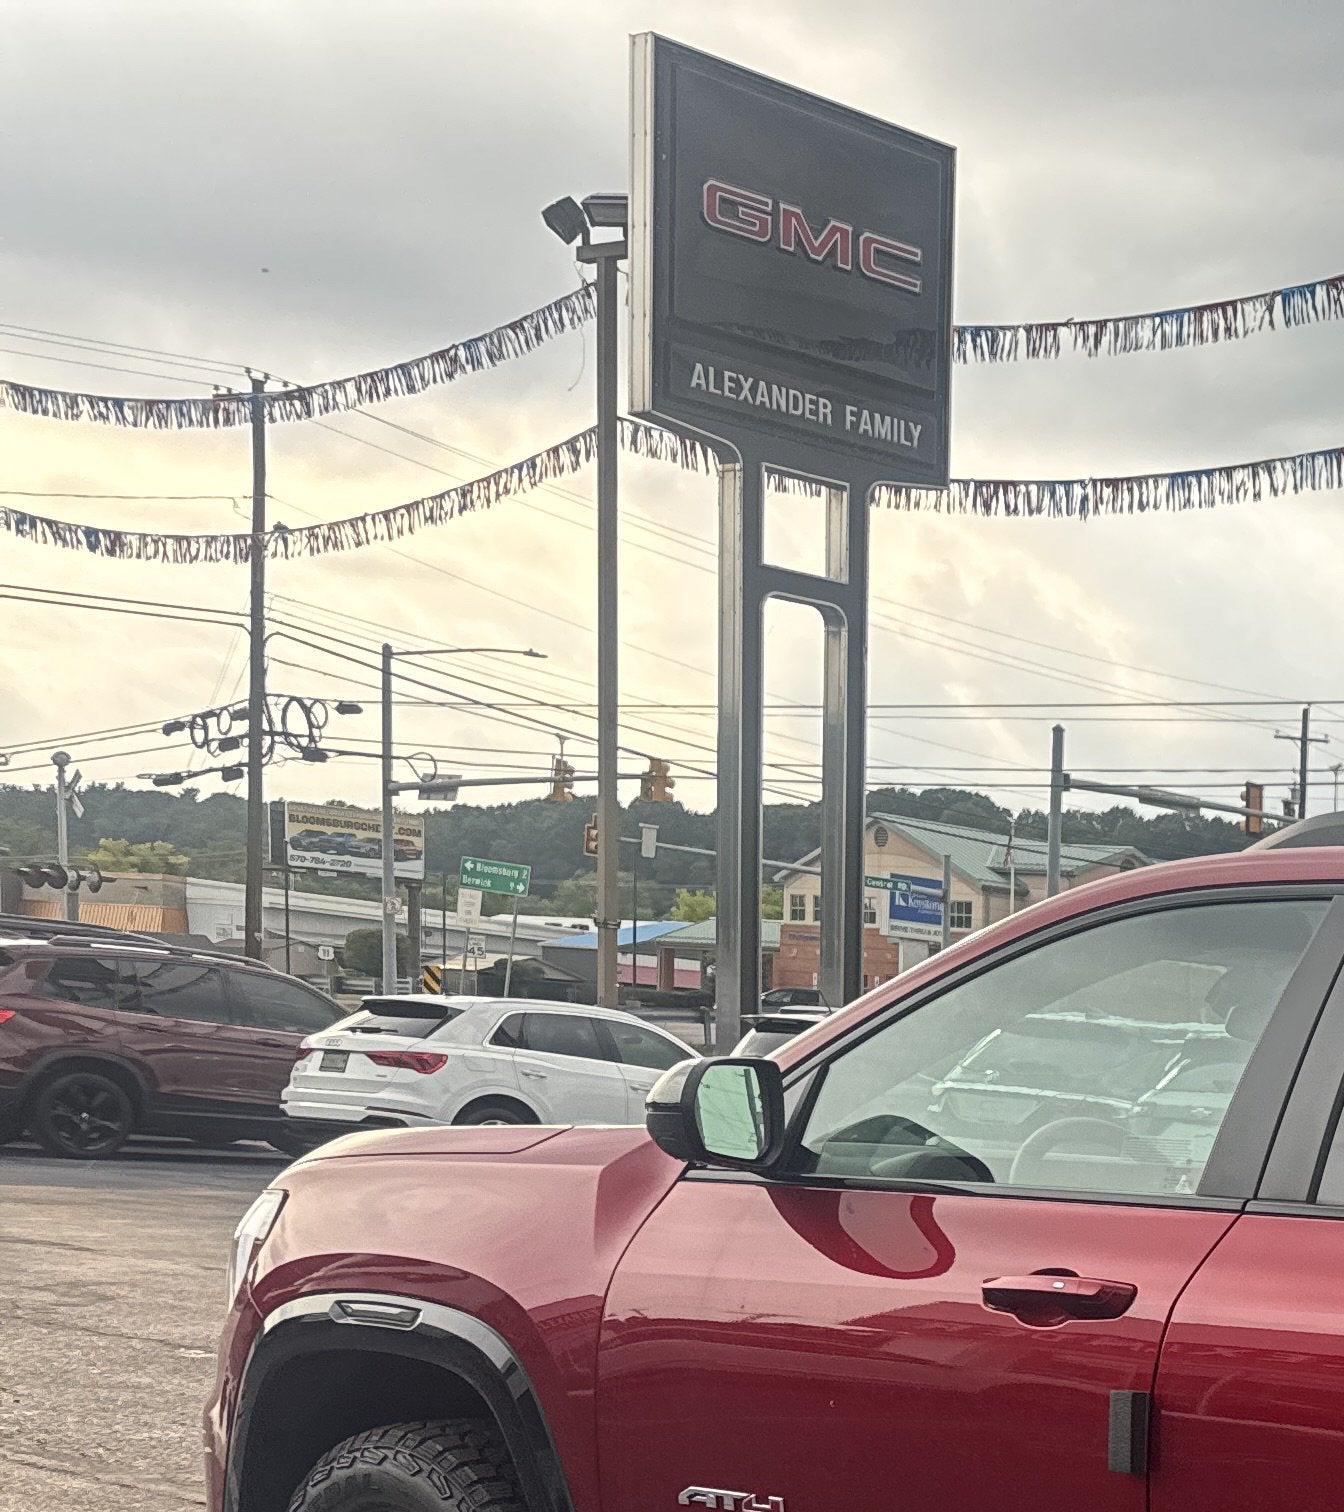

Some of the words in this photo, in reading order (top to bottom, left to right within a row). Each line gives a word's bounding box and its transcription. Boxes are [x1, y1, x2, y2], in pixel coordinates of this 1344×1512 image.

[702, 179, 922, 293] GMC
[690, 362, 833, 427] ALEXANDER
[844, 403, 923, 449] FAMILY
[467, 946, 484, 956] 45
